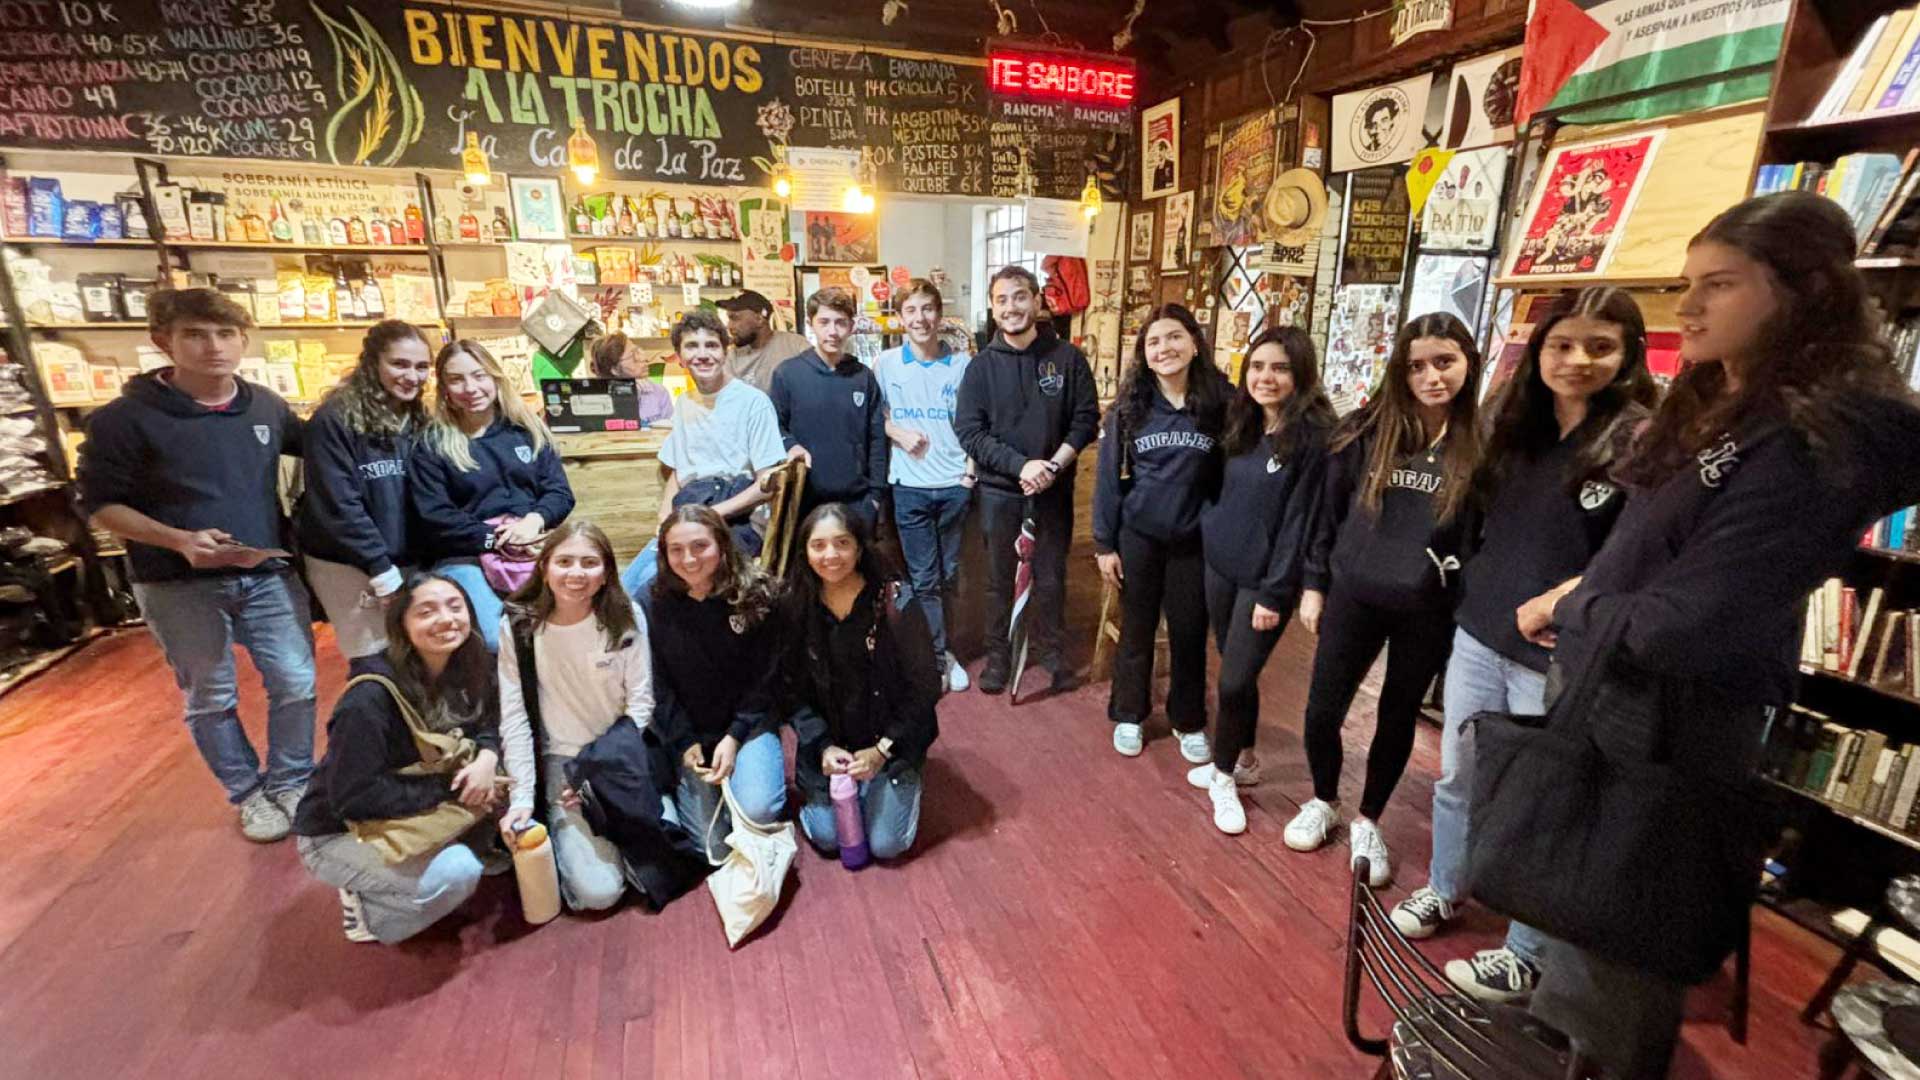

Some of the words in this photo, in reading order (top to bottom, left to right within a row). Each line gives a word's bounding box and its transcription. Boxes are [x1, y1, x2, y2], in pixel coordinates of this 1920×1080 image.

[270, 24, 303, 45] 36
[282, 48, 313, 69] 49
[404, 9, 763, 93] BIENVENIDOS
[789, 49, 873, 74] CERVEZA
[889, 59, 958, 80] EMPANADA
[289, 71, 322, 91] 12
[795, 76, 856, 97] BOTELLA
[889, 79, 944, 96] CRIOLLA
[83, 85, 118, 109] 49
[312, 91, 328, 111] 9
[465, 67, 503, 123] A
[506, 71, 550, 125] LA
[549, 76, 722, 139] TROCHA
[800, 106, 853, 127] PINTA
[892, 108, 963, 129] ARGENTINA
[1003, 102, 1055, 118] RANCHA
[1073, 107, 1120, 124] RANCHA
[280, 117, 316, 141] 29
[892, 127, 961, 144] MEXICANA
[302, 141, 317, 159] 9
[615, 137, 643, 171] de
[655, 139, 687, 174] La
[690, 139, 745, 181] Paz
[902, 144, 958, 162] POSTRES
[902, 161, 958, 176] FALAFEL
[902, 178, 951, 193] QUIBBE
[893, 408, 926, 420] CMA
[927, 407, 949, 420] CG
